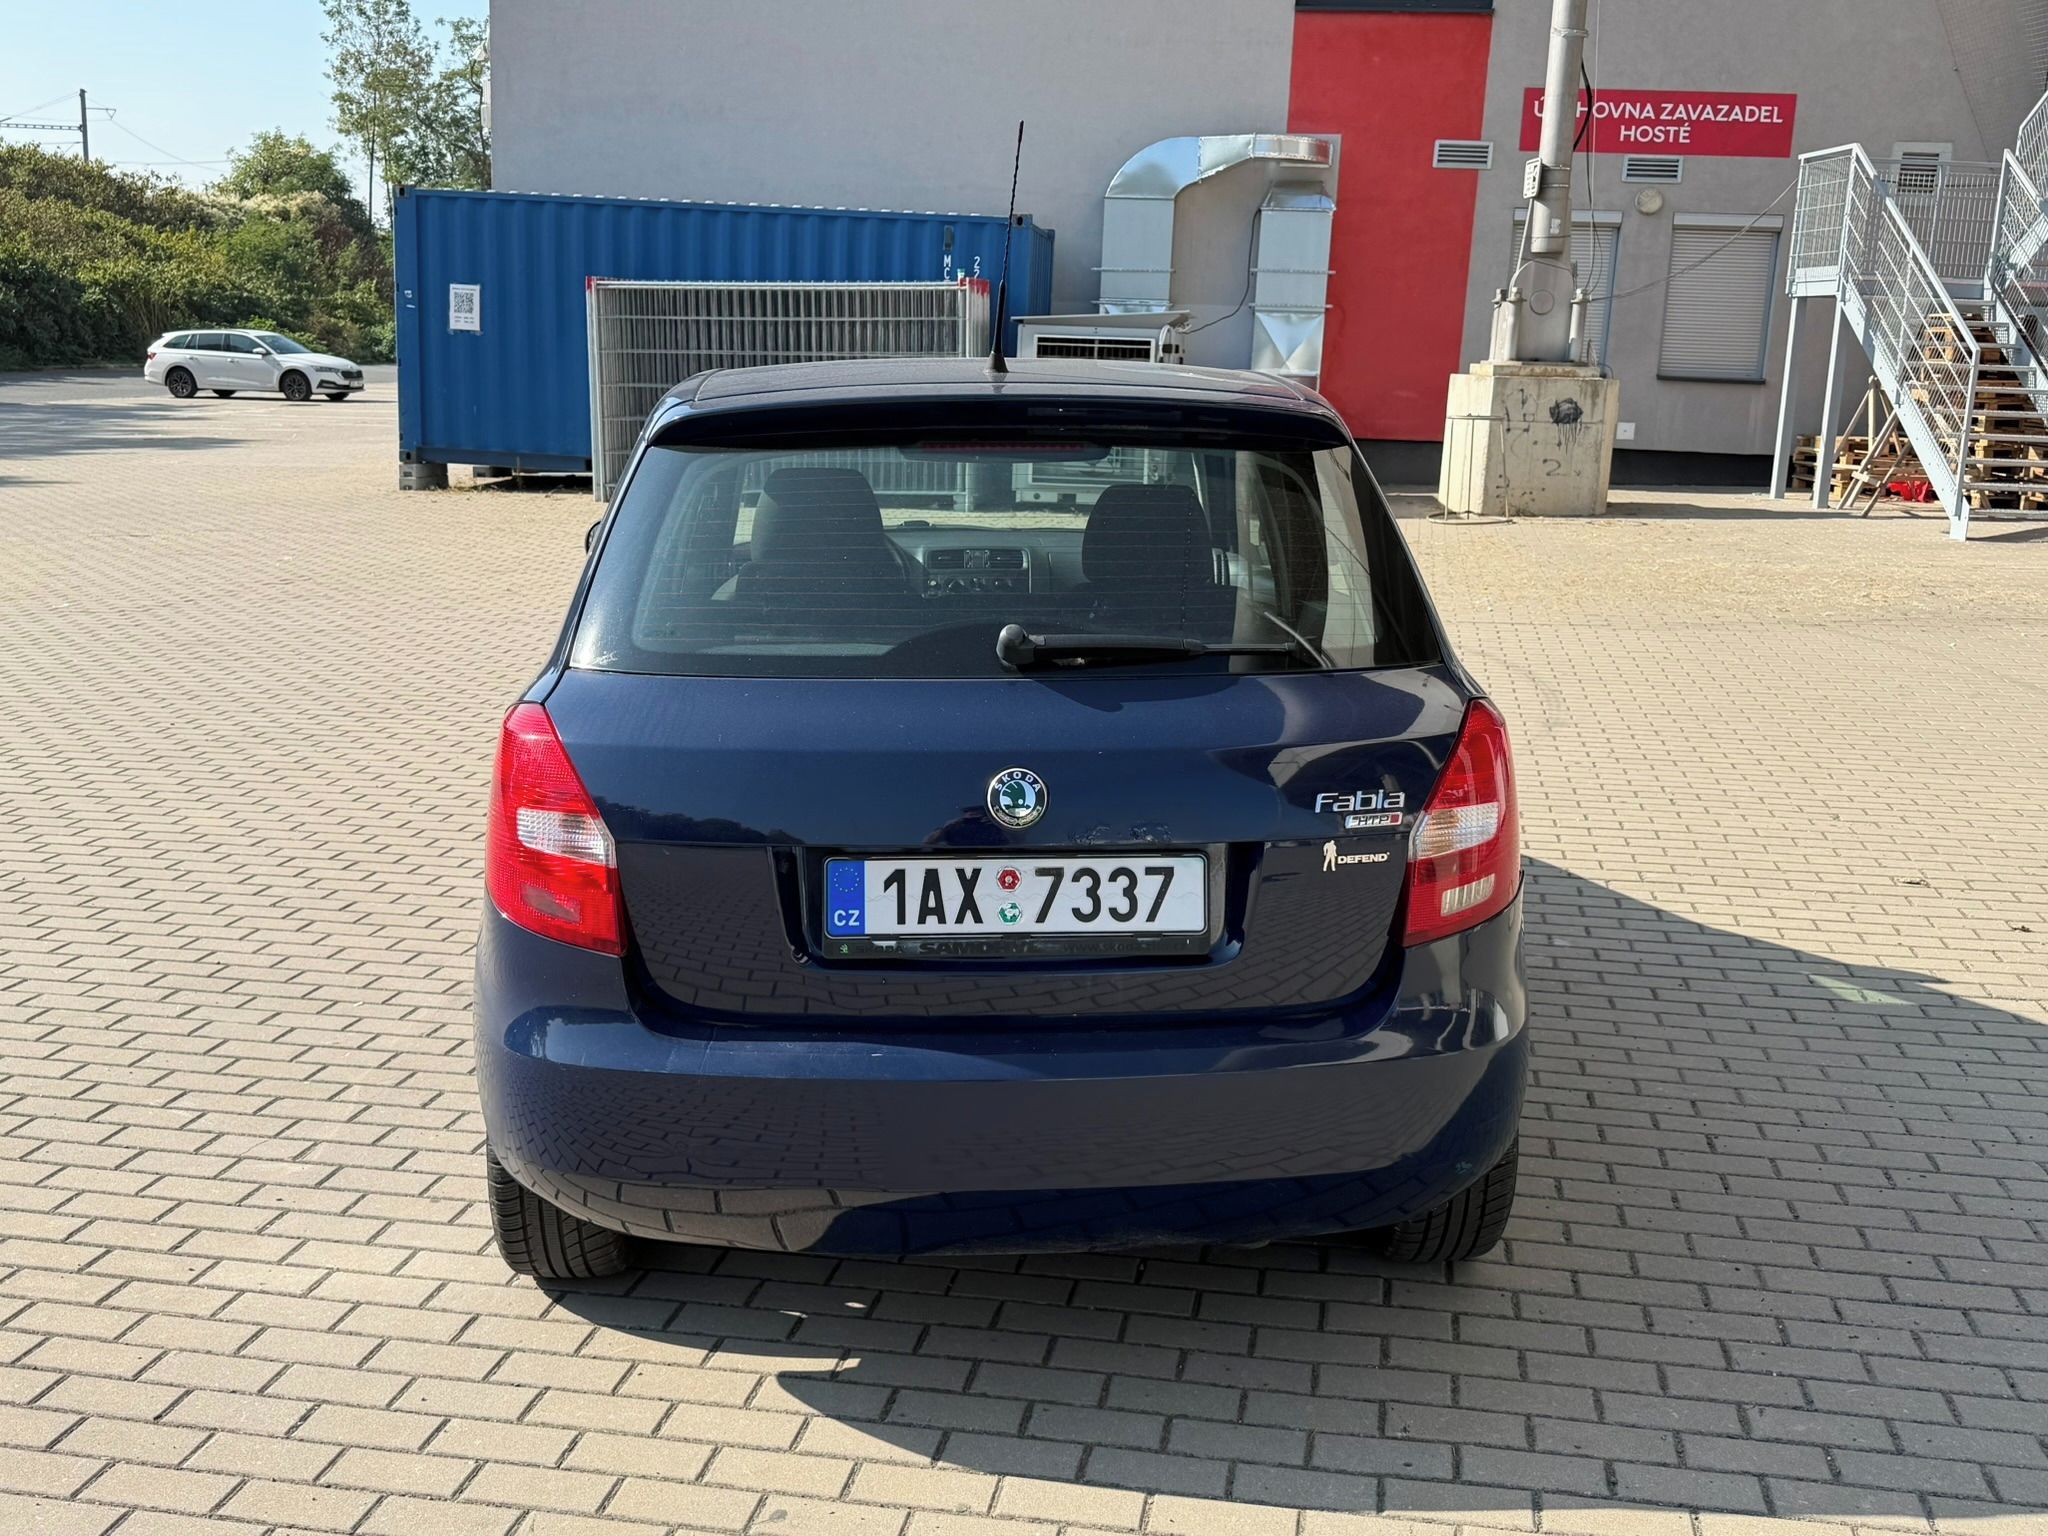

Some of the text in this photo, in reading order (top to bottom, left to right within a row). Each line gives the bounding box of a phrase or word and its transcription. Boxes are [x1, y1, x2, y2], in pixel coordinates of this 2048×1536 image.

[1534, 96, 1784, 123] ÚHOVNA ZAVAZADEL
[1620, 122, 1691, 143] HOSTÉ
[883, 866, 1175, 925] 1AX 7337
[834, 909, 860, 926] CZ
